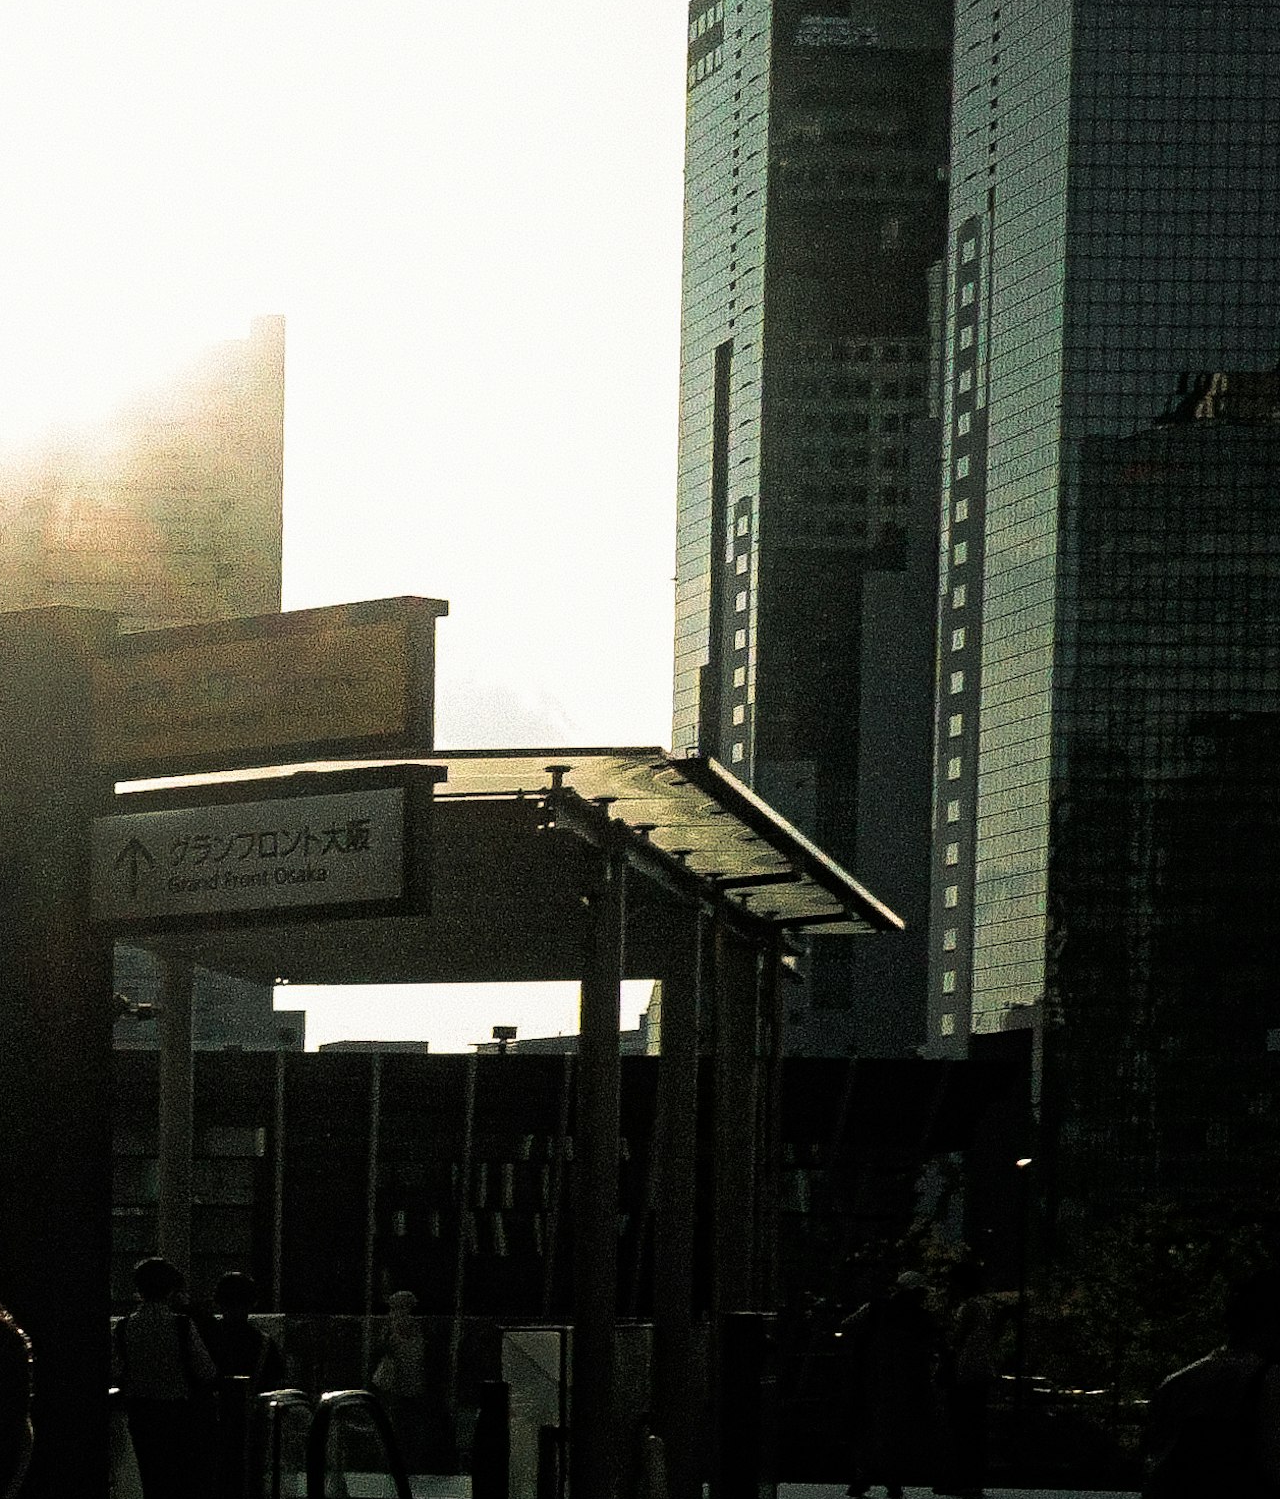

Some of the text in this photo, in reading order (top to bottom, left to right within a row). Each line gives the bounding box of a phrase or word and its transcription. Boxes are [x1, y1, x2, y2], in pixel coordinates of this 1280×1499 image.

[170, 819, 371, 866] グランフロント大阪
[167, 869, 219, 894] Grand
[274, 863, 328, 885] Osaka
